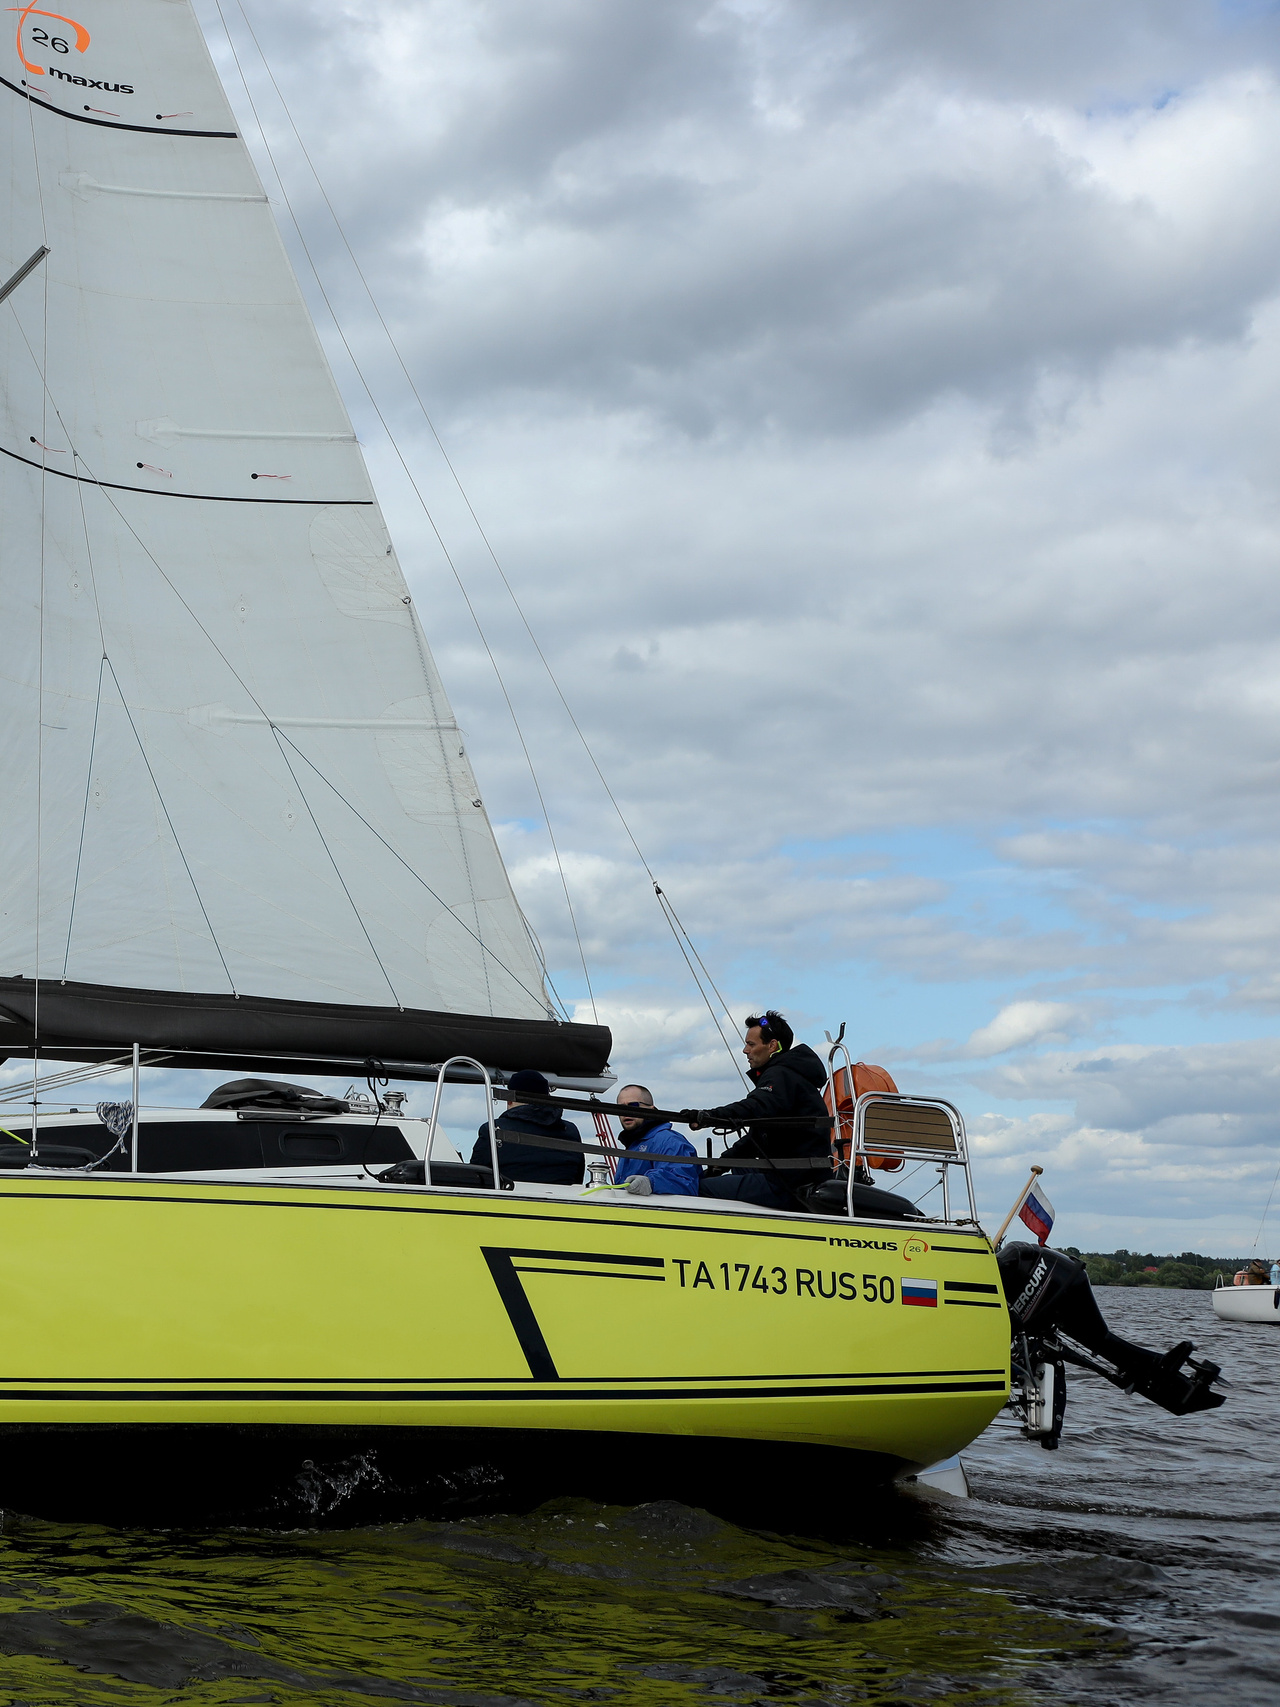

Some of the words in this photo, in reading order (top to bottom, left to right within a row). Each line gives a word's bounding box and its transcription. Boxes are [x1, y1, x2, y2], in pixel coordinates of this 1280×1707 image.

[31, 27, 70, 54] 26
[49, 66, 135, 95] maxus
[829, 1237, 898, 1252] maxus
[908, 1245, 922, 1253] 26
[1011, 1257, 1048, 1315] ERCURY
